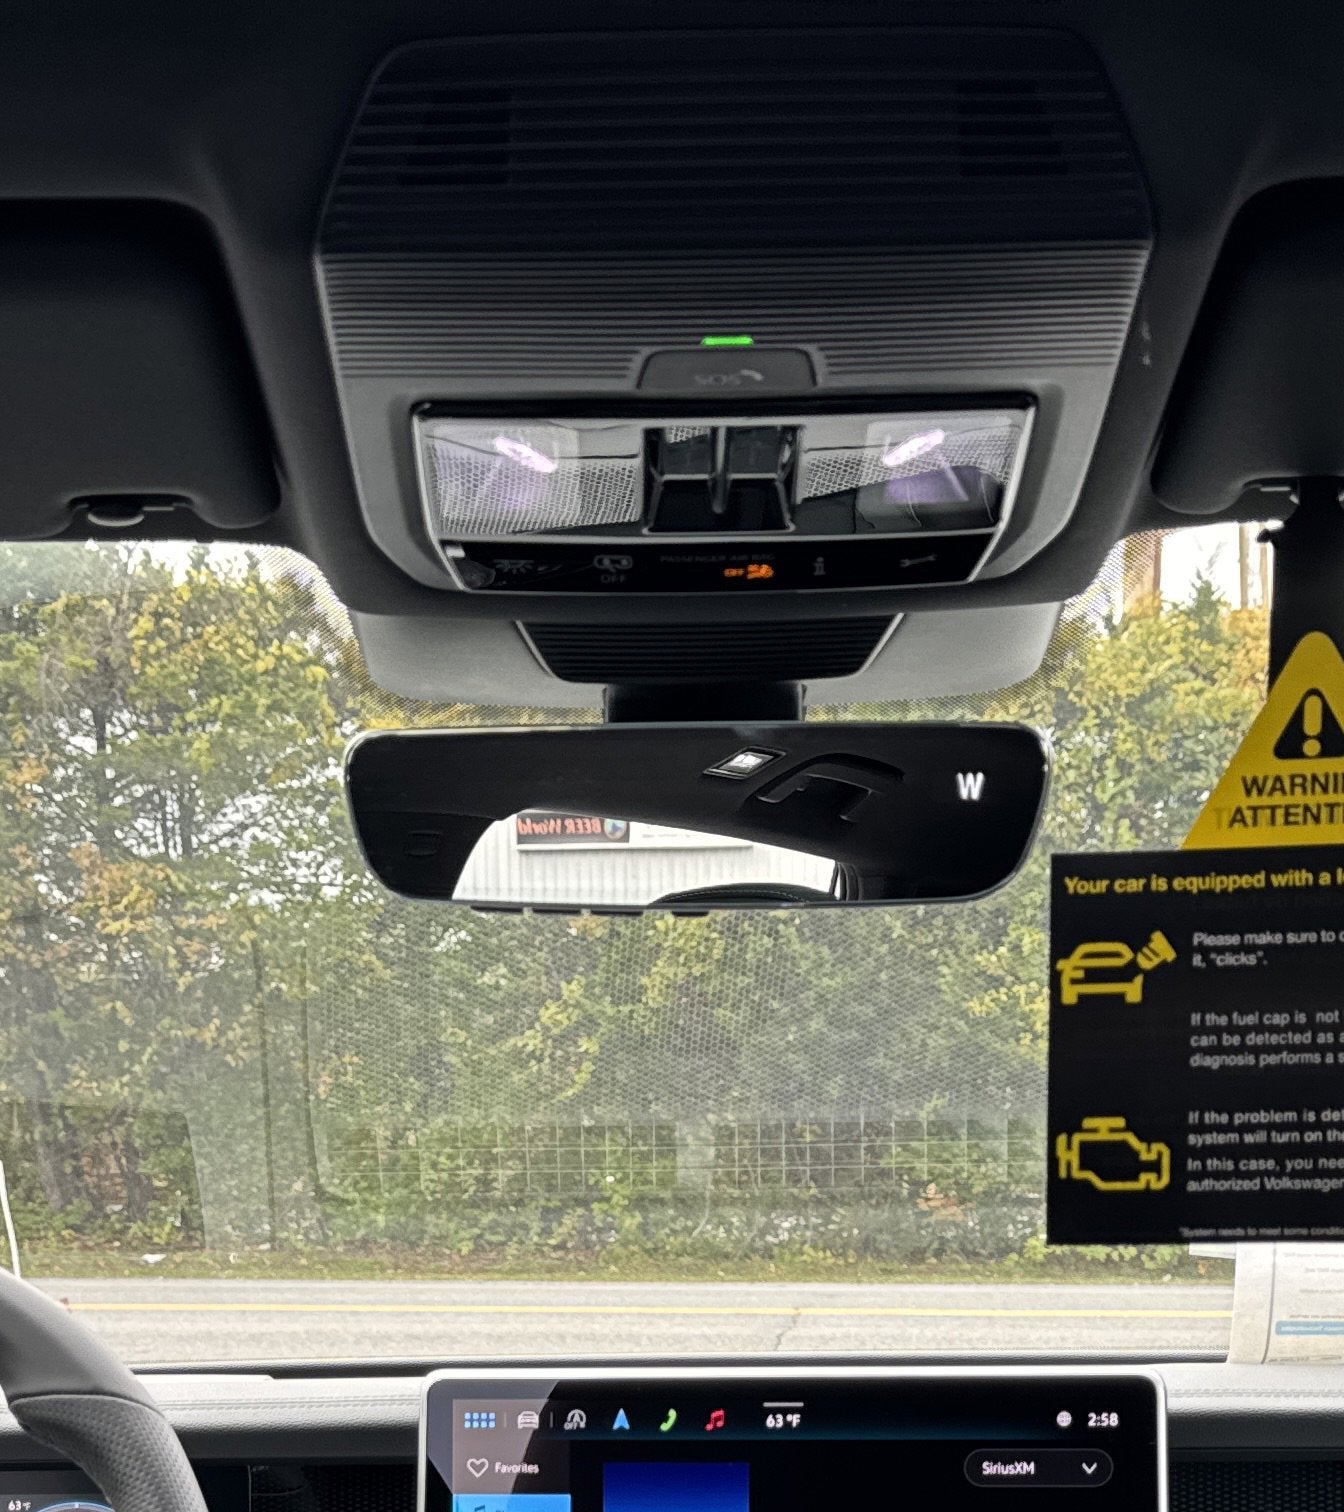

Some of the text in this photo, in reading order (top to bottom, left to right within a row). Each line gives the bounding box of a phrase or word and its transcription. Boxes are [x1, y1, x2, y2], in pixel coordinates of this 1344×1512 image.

[956, 771, 985, 801] W
[1065, 875, 1110, 896] Your
[1114, 876, 1146, 893] car
[1151, 874, 1169, 893] is
[1173, 871, 1267, 894] equipped
[1271, 869, 1315, 888] with
[1318, 872, 1332, 886] a
[1193, 932, 1241, 947] Please
[1244, 931, 1284, 944] make
[1286, 931, 1318, 943] sure
[1320, 930, 1337, 942] to
[1191, 1012, 1203, 1027] If
[1206, 1012, 1229, 1027] the
[1232, 1011, 1259, 1026] fuel
[1262, 1013, 1290, 1028] cap
[1293, 1010, 1307, 1025] is
[1315, 1009, 1340, 1023] not
[1190, 1034, 1218, 1047] can
[1221, 1031, 1241, 1046] be
[1245, 1030, 1312, 1046] detected
[1316, 1031, 1335, 1044] as
[1190, 1052, 1256, 1070] diagnosis
[1259, 1051, 1322, 1069] performs
[1204, 1110, 1229, 1125] the
[1233, 1109, 1298, 1126] problem
[1188, 1131, 1240, 1147] system
[1244, 1130, 1267, 1144] will
[1270, 1129, 1300, 1144] turn
[1206, 1157, 1235, 1172] this
[1238, 1157, 1282, 1173] case,
[1284, 1157, 1313, 1173] you
[1186, 1176, 1261, 1192] authorized
[766, 1413, 785, 1429] 63
[1087, 1411, 1120, 1427] 2:58
[494, 1461, 540, 1475] Favorites
[981, 1460, 1035, 1476] SiriusXM
[7, 1500, 22, 1512] 63
